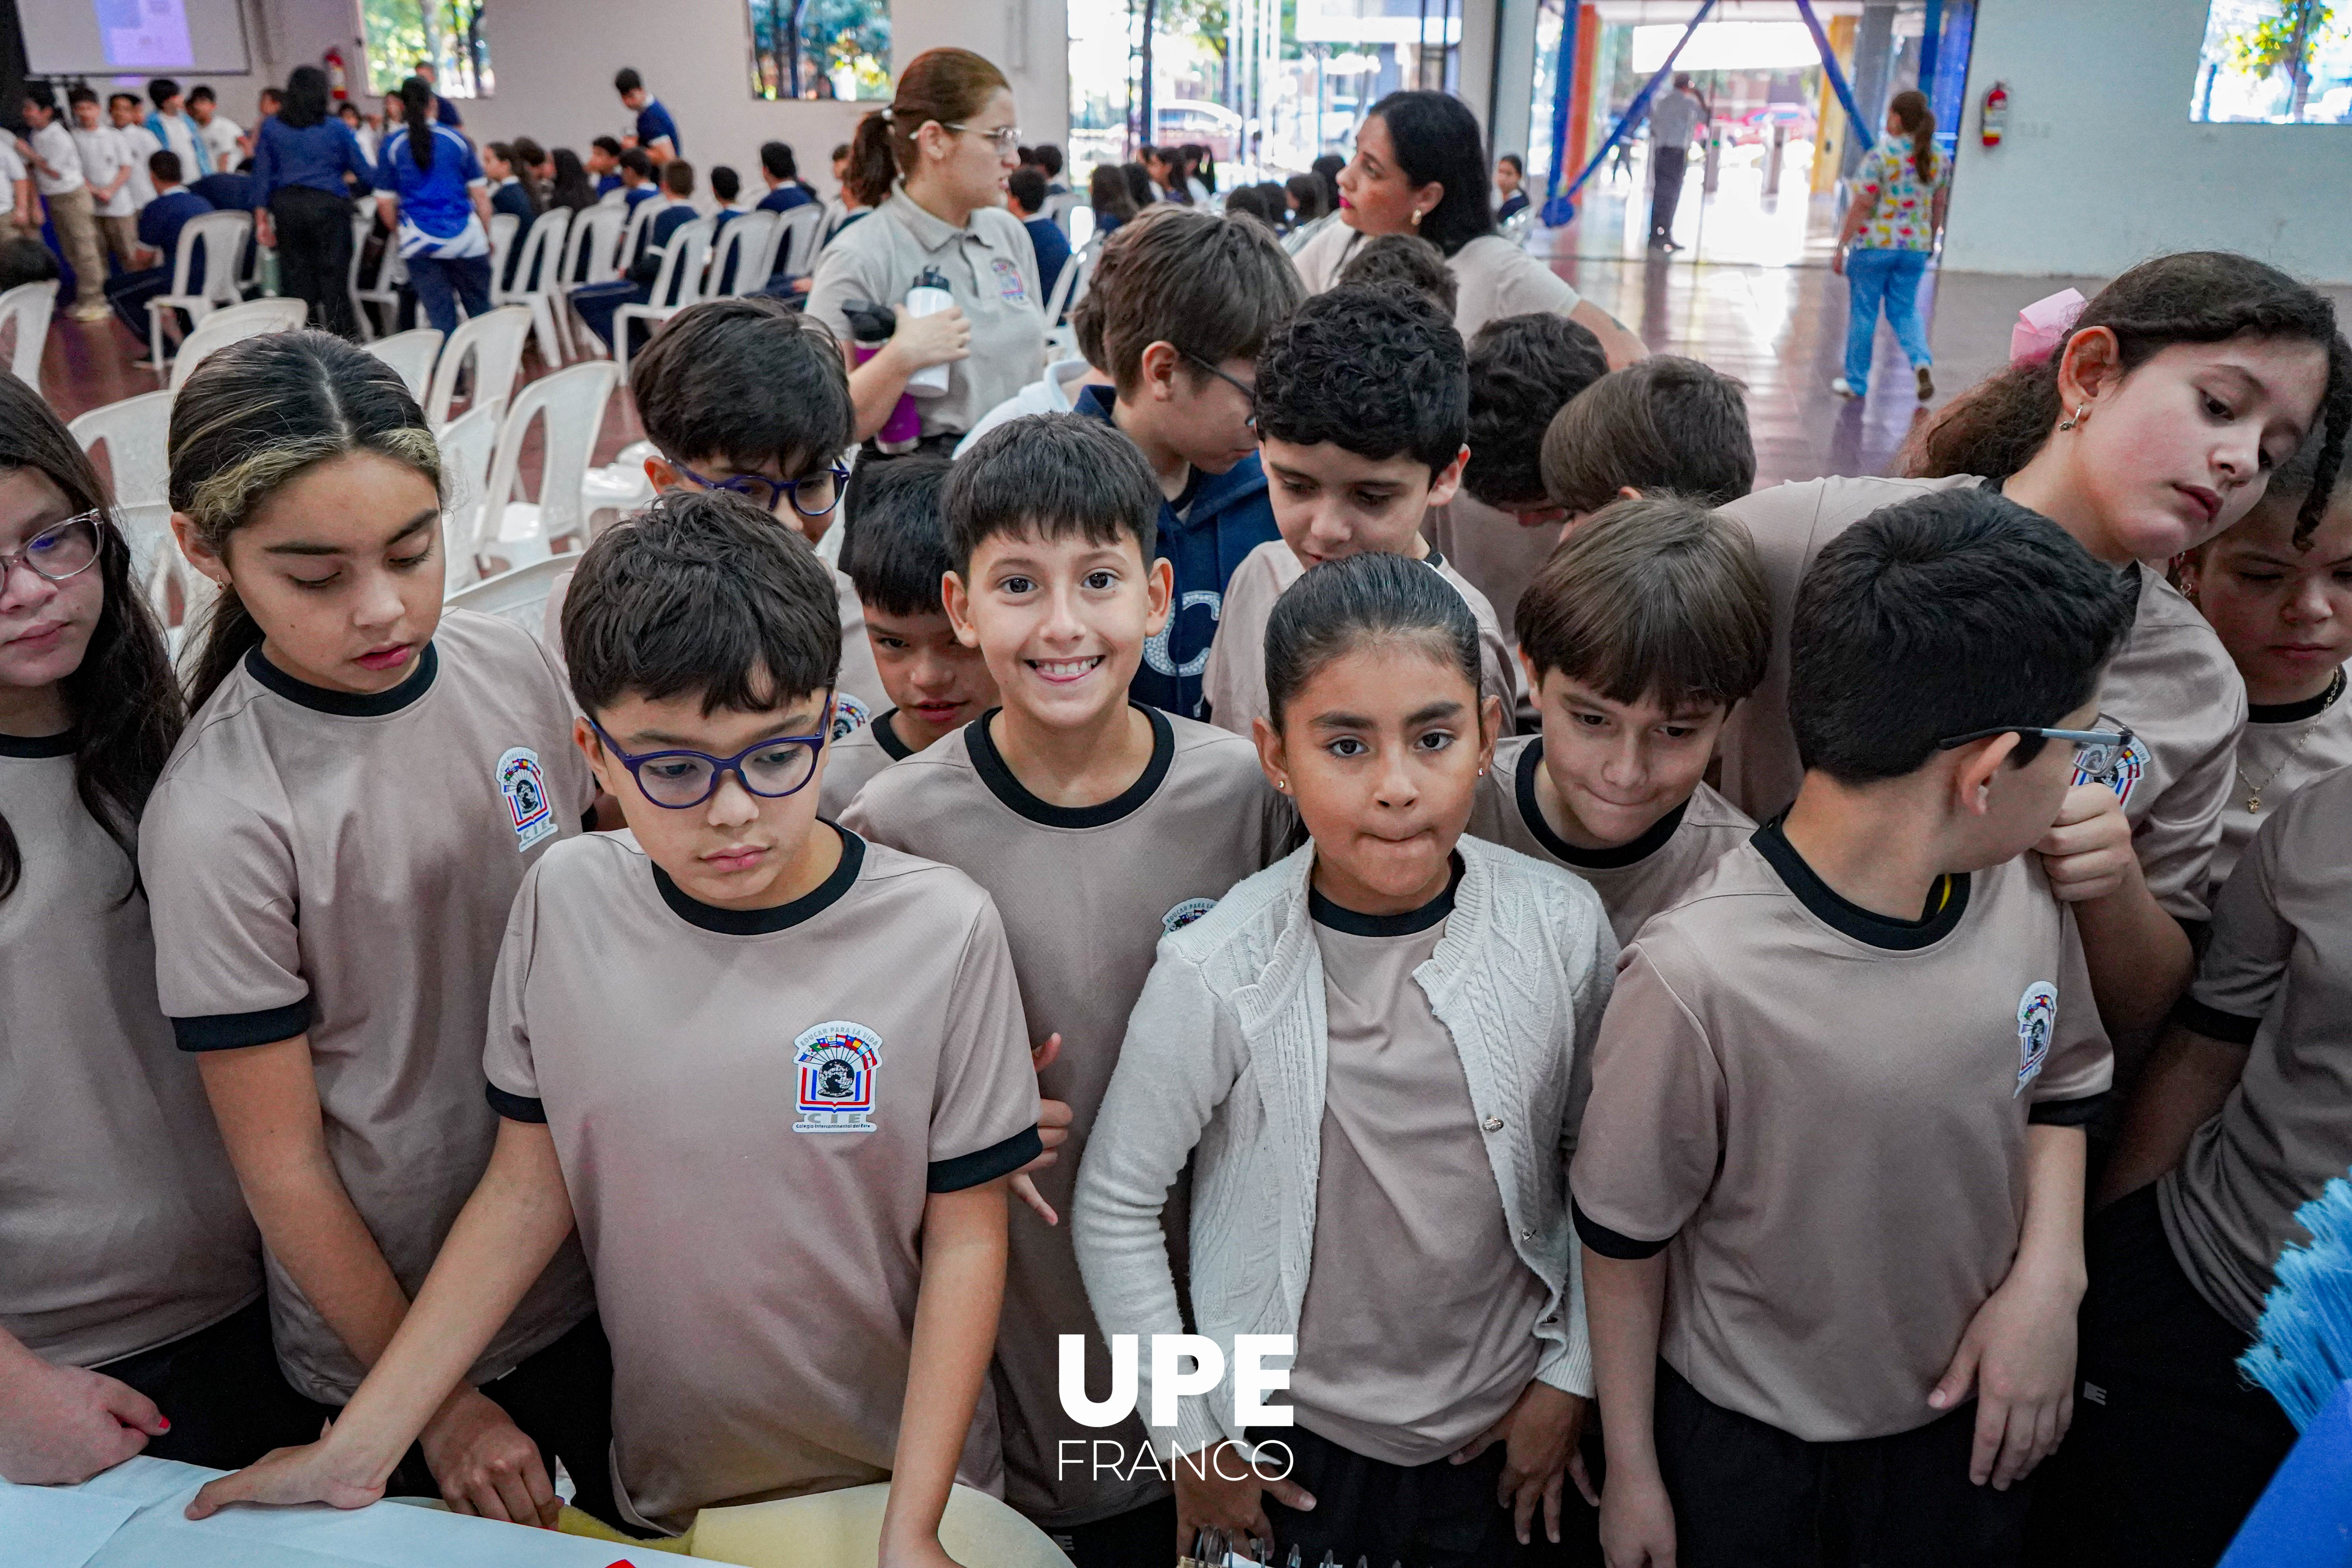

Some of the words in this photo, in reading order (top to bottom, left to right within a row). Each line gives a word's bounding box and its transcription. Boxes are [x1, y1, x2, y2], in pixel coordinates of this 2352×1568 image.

[523, 818, 548, 840] CIE
[1167, 906, 1187, 923] EDUCAR
[800, 1029, 828, 1046] EDUCAR
[863, 1032, 878, 1046] VIDA
[808, 1113, 861, 1123] CIE
